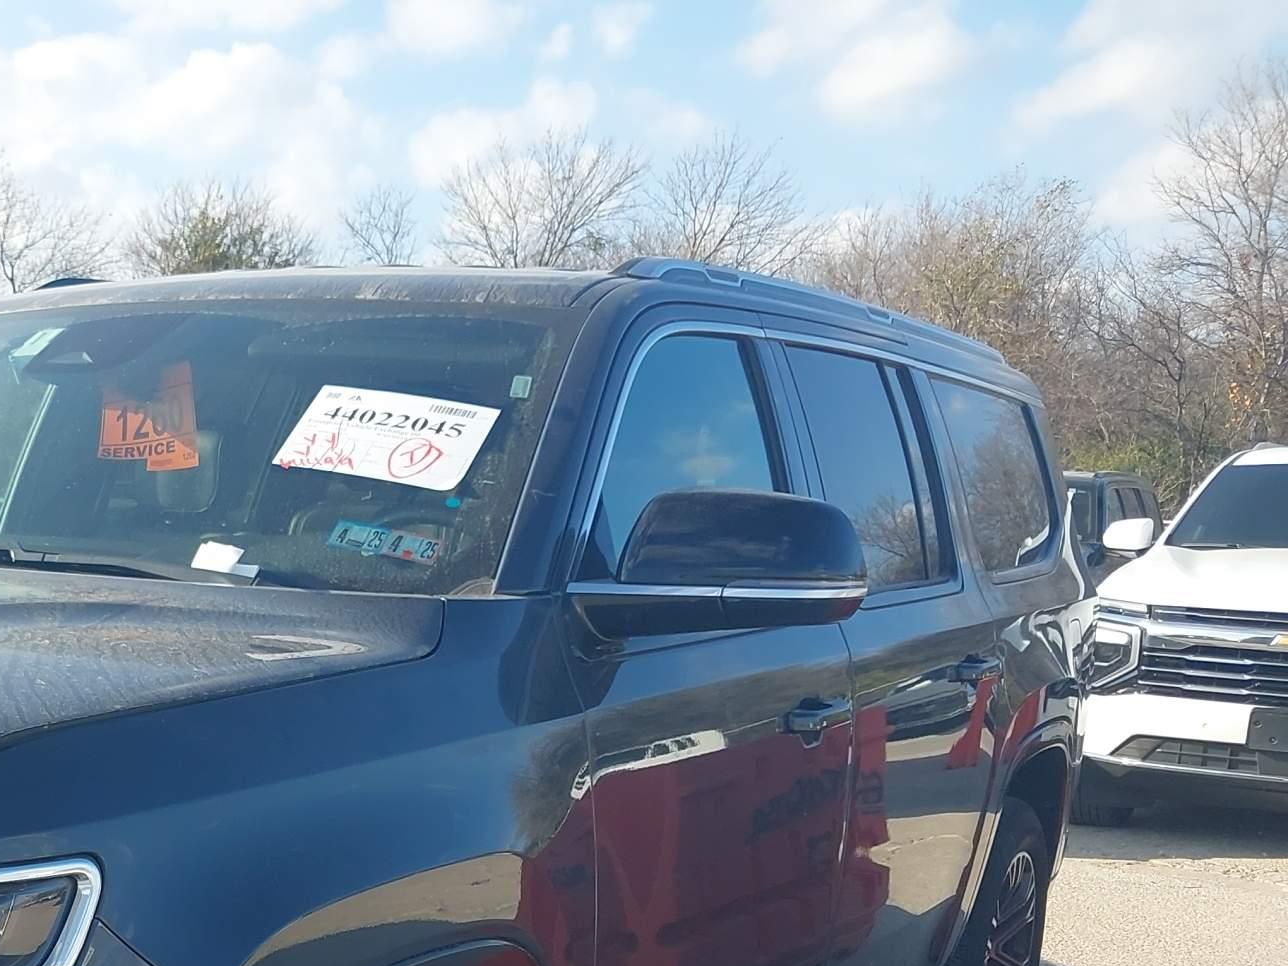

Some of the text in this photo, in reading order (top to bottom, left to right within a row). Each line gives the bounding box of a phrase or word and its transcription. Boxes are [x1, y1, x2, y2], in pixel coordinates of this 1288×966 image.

[323, 406, 466, 439] 44022045
[101, 440, 177, 458] SERVICE
[367, 530, 386, 549] 25
[420, 541, 439, 560] 25
